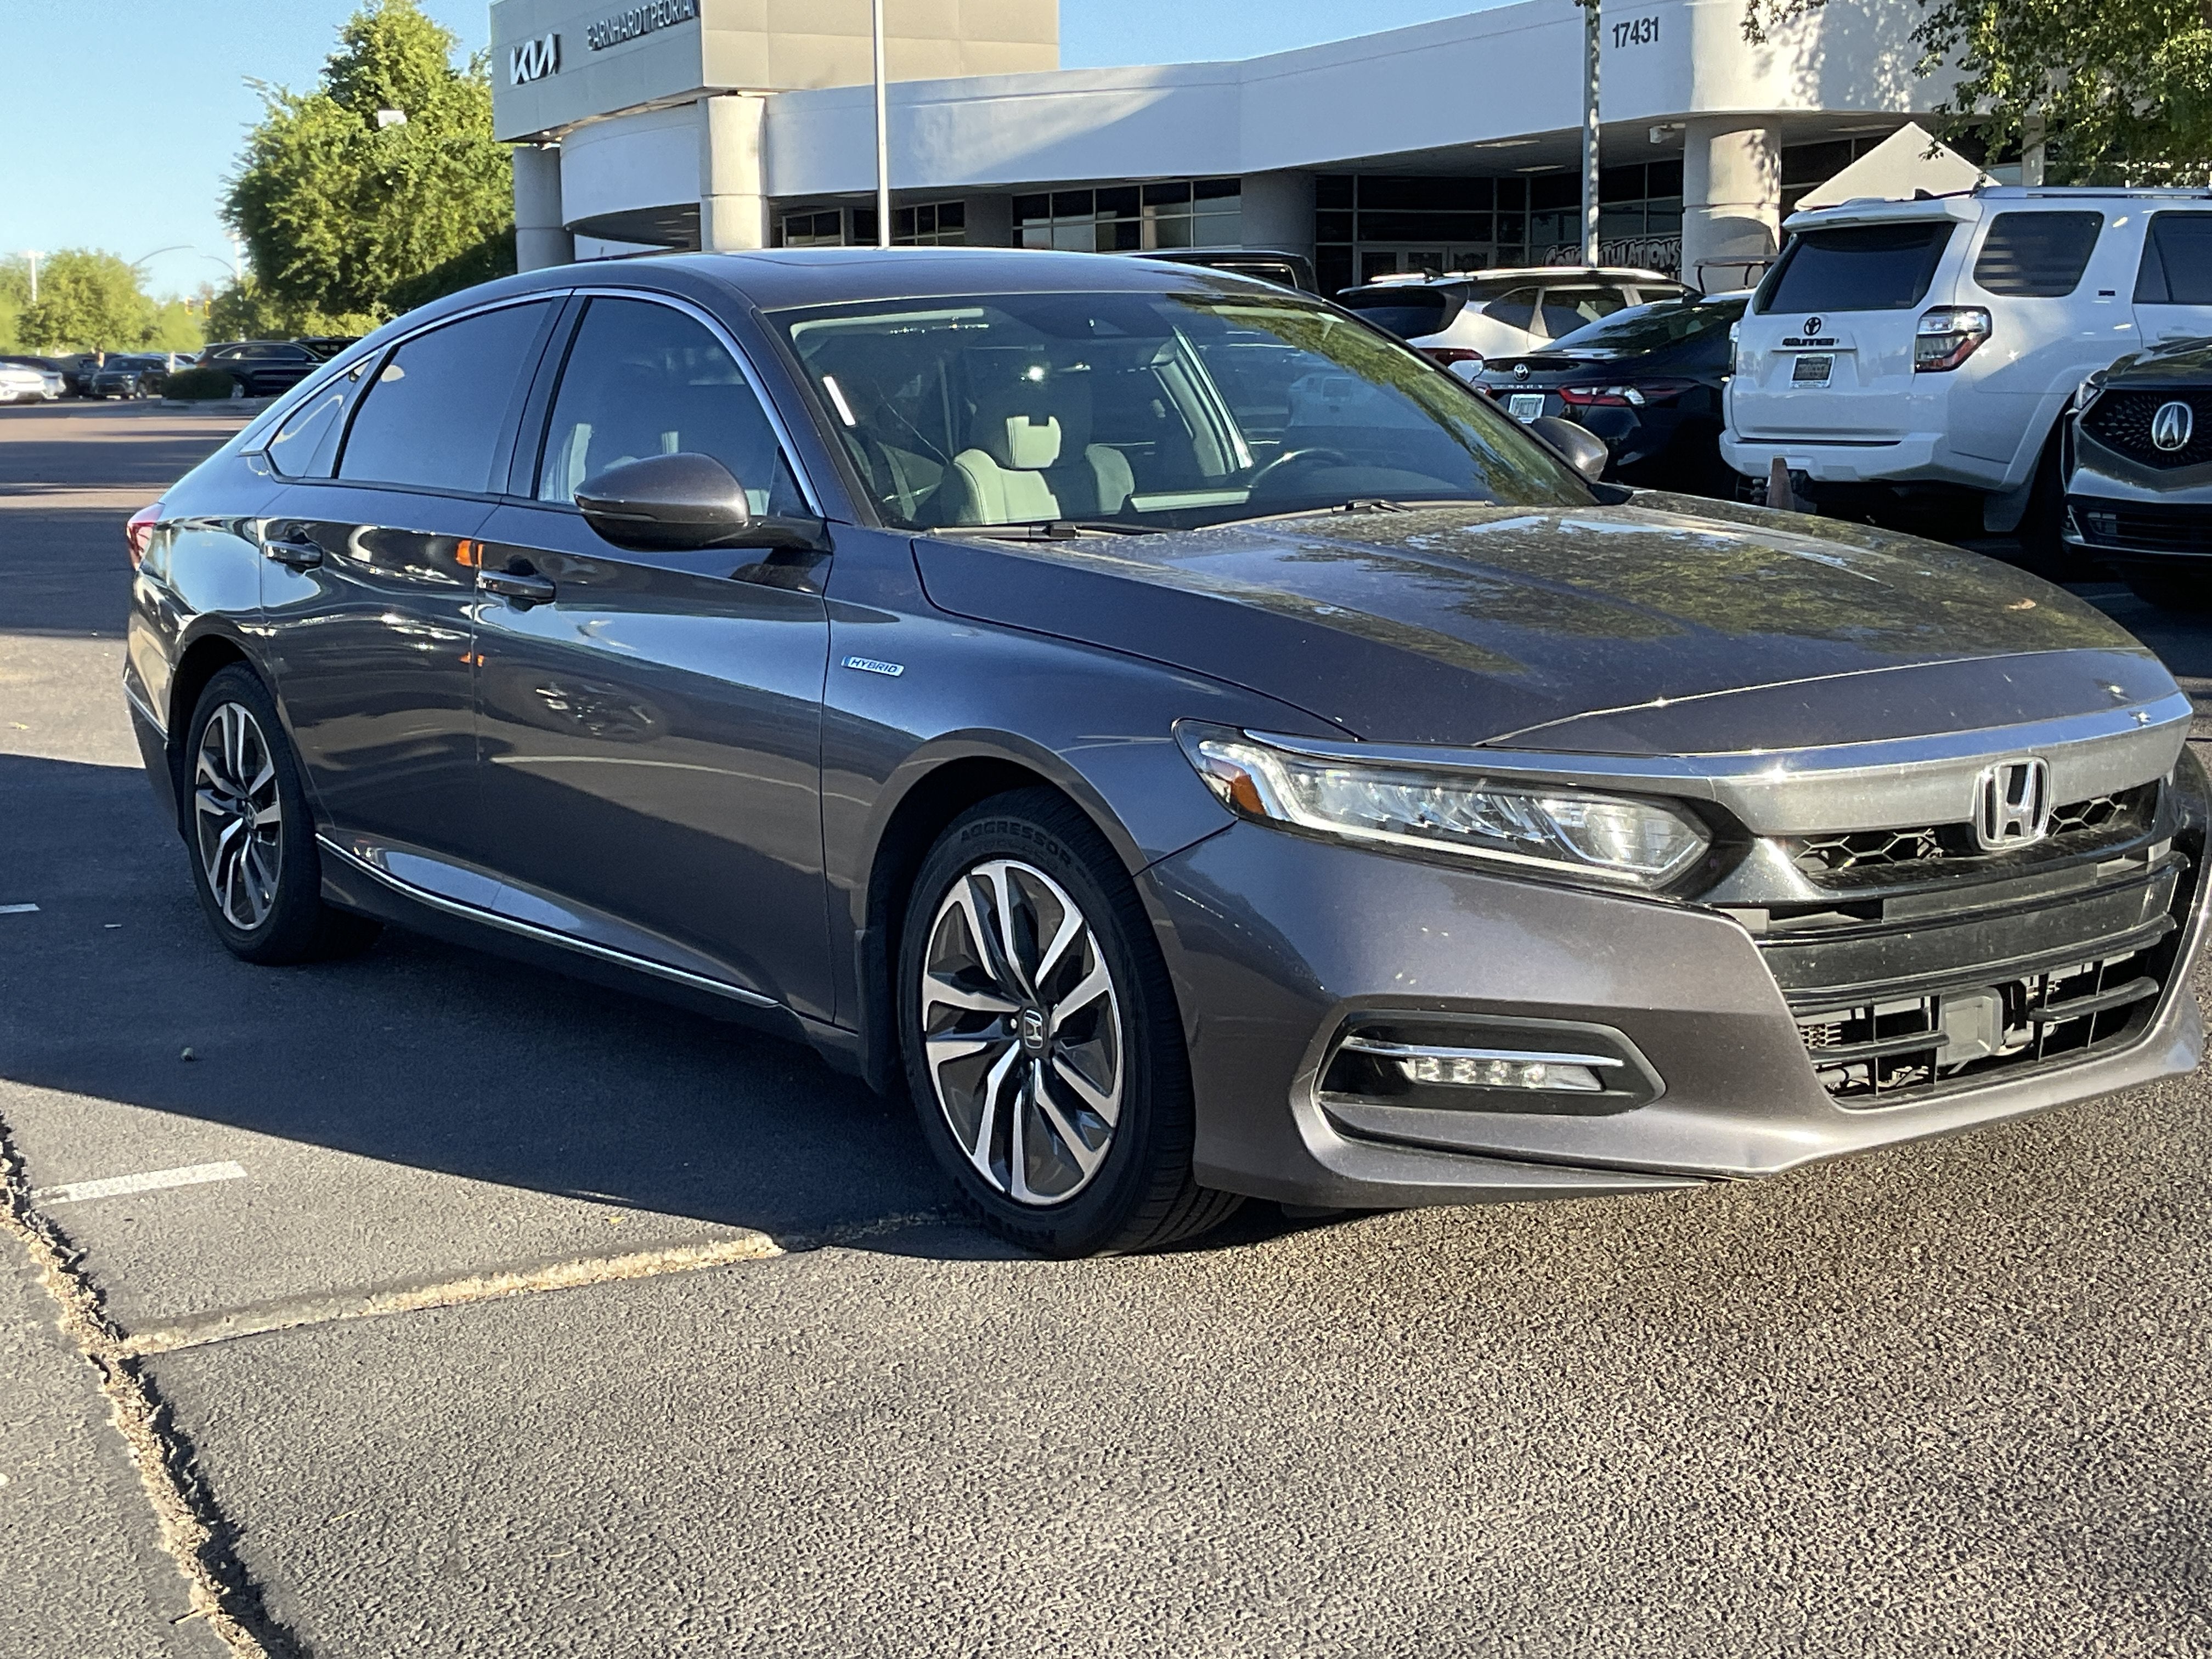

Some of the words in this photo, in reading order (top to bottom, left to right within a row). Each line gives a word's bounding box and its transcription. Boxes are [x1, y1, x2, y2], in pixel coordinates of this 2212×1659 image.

[585, 7, 651, 51] EARNHARDT
[651, 0, 696, 30] PEORIA
[1612, 16, 1659, 48] 17431
[510, 33, 556, 86] KIA
[851, 659, 898, 673] HYBRID
[961, 821, 1071, 867] AGGRESSOR
